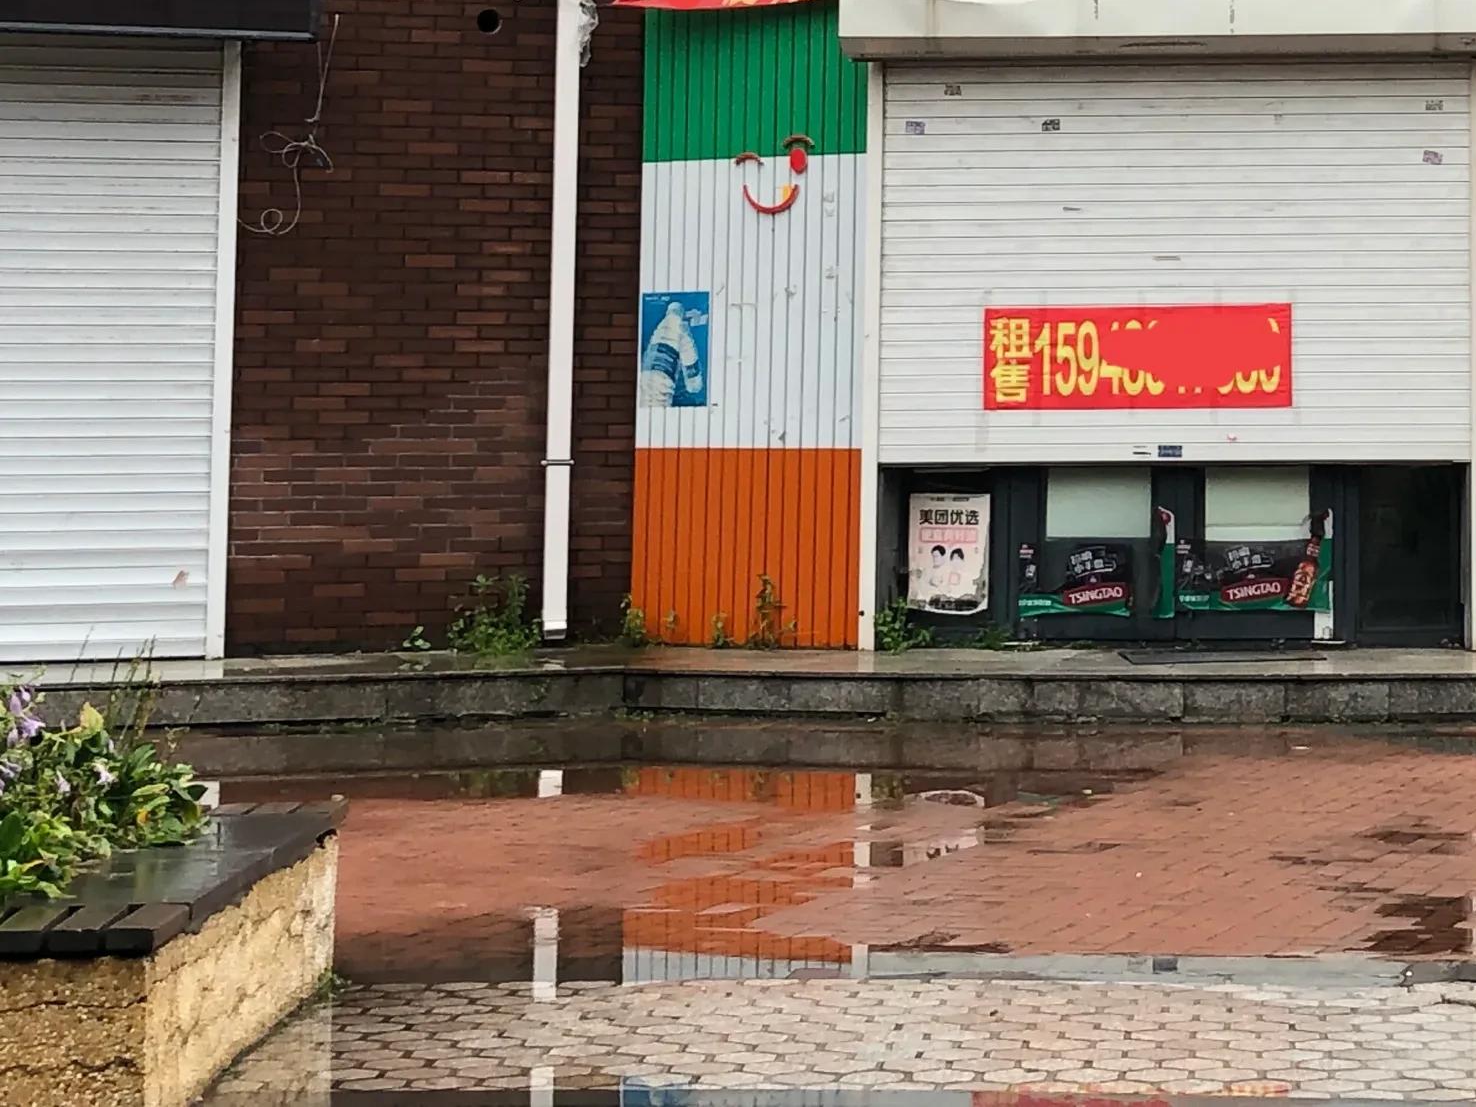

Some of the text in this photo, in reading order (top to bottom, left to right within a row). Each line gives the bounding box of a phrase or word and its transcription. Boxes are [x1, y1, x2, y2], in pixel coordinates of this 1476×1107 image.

[989, 317, 1033, 403] 租售
[919, 509, 979, 526] 美团优选
[1068, 586, 1123, 604] TSINGTAO
[1225, 581, 1282, 600] TSINGTAO
